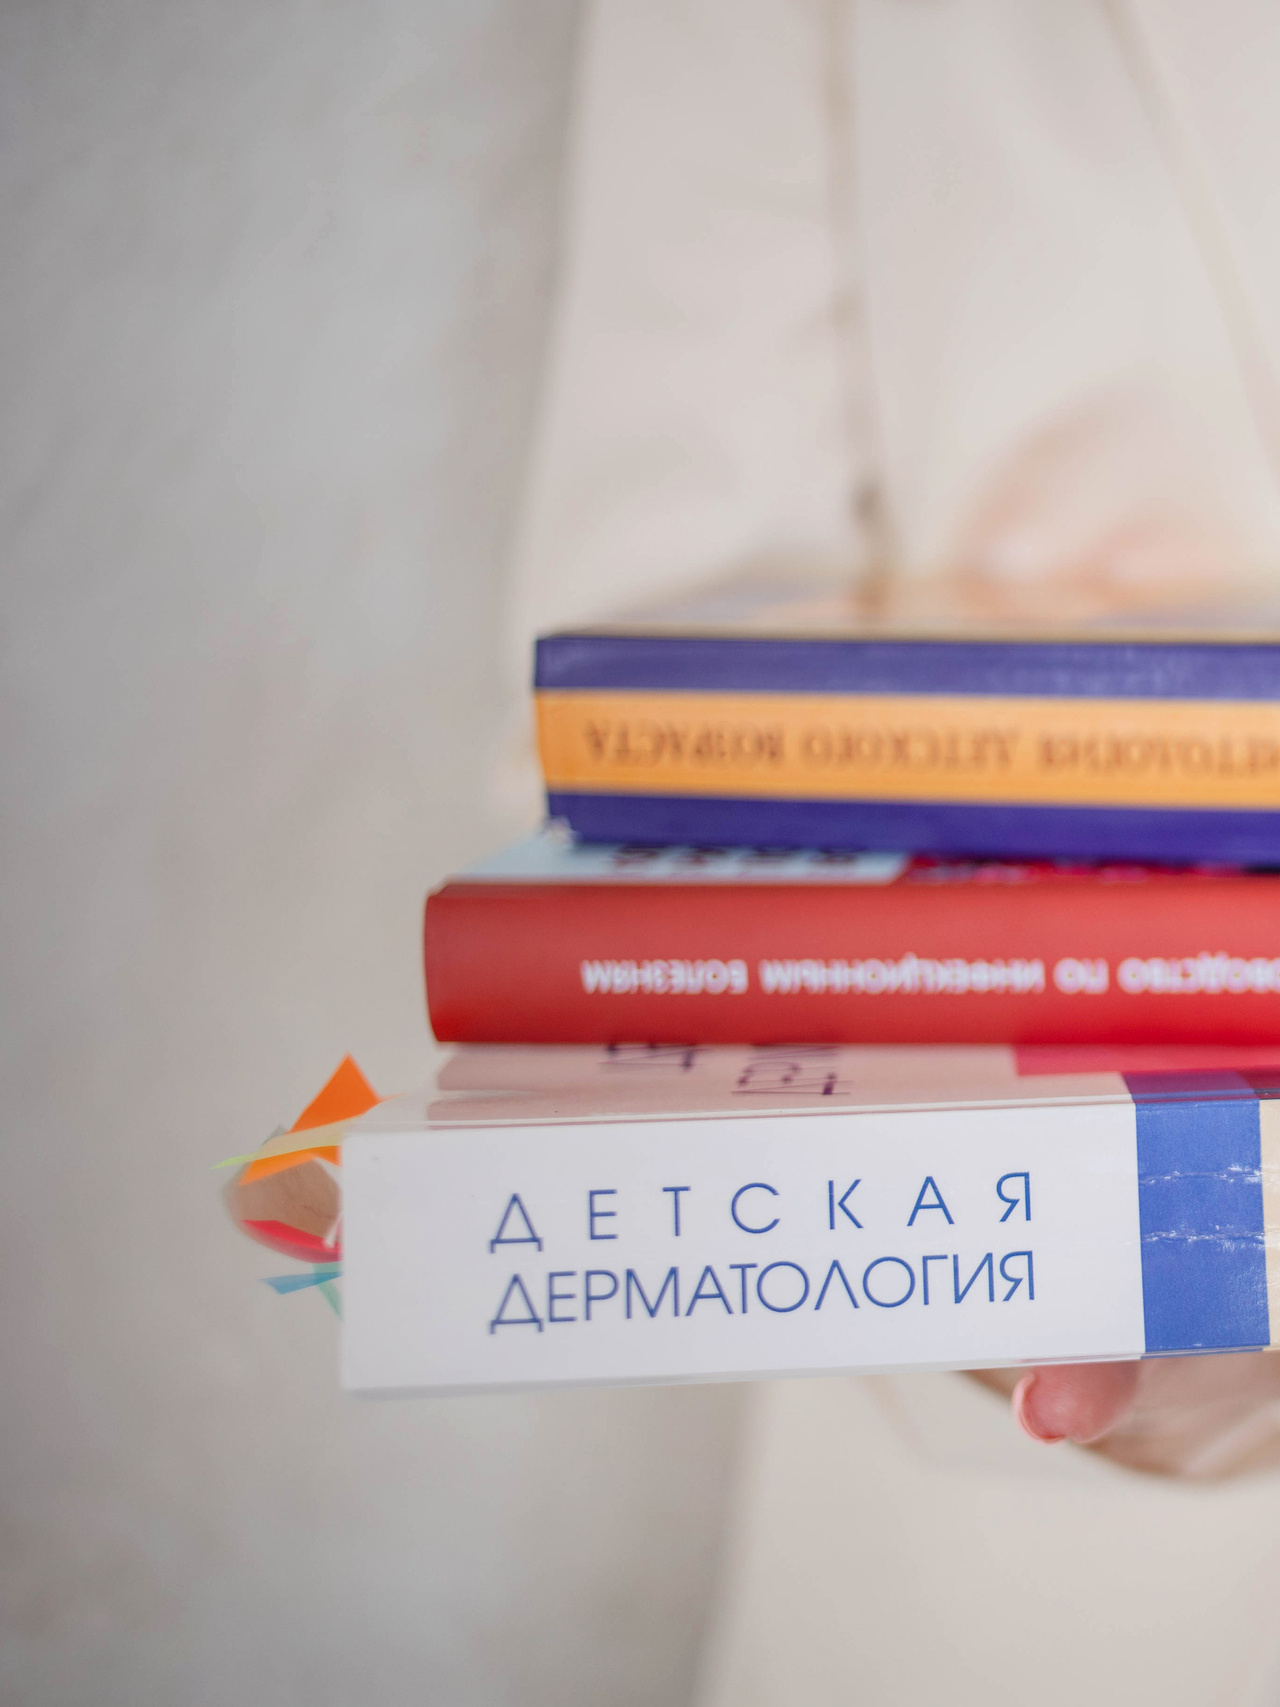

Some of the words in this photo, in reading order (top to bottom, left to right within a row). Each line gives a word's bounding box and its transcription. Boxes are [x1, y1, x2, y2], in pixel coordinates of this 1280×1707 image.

[583, 720, 784, 769] ВОЗРАСТА
[798, 724, 1018, 775] ДЕТСКОГО
[582, 958, 749, 996] БОЛЕЗНЯМ
[758, 952, 1046, 997] ИНФЕКЦИОННЫМ
[1053, 957, 1109, 995] ПО
[489, 1171, 1033, 1254] ДЕТСКАЯ
[489, 1250, 1036, 1334] ДЕРМАТОЛОГИЯ
